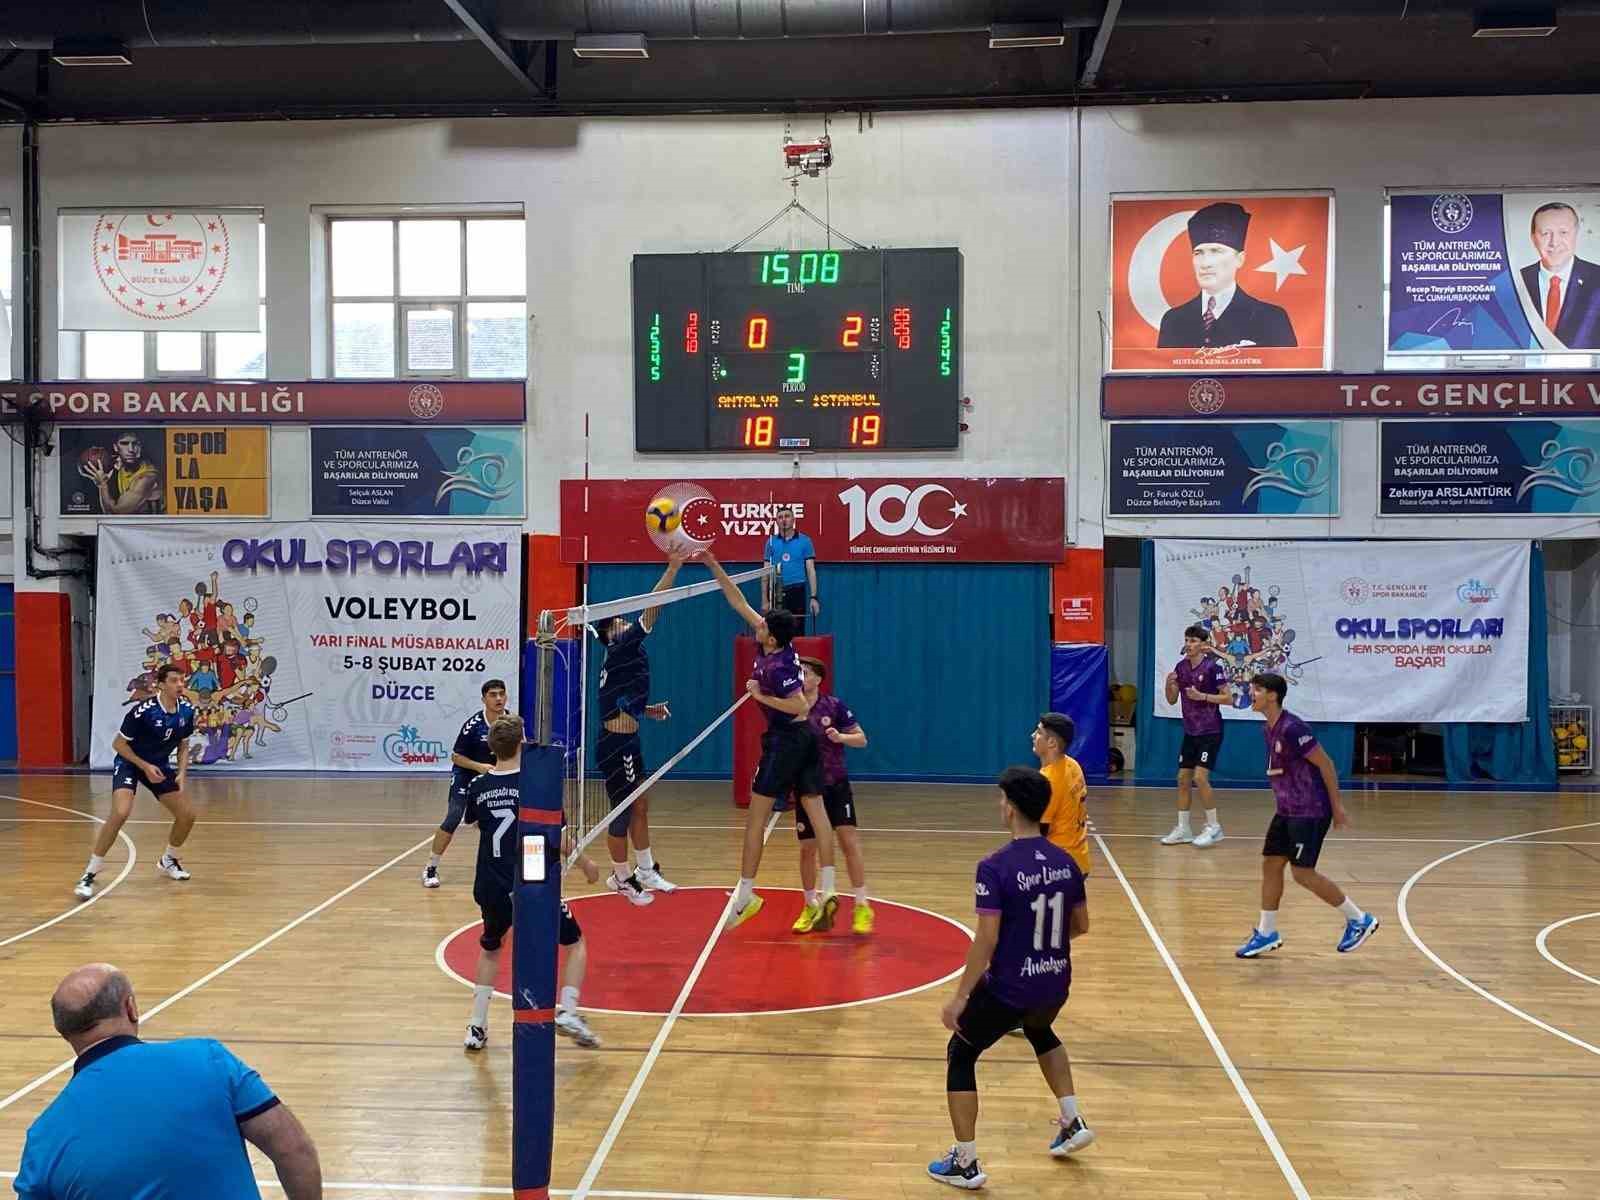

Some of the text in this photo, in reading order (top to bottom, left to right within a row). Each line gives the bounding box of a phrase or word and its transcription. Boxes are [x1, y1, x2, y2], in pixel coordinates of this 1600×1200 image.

[1413, 240, 1490, 250] TÜM ANTRENÖR
[1401, 251, 1502, 260] VE SPORCULARIMIZA
[1401, 262, 1501, 273] BAŞARILAR DİLİYORUM
[787, 282, 806, 294] TIME
[1406, 284, 1496, 294] Recep Tayyip ERDOĞAN
[748, 318, 768, 349] 0
[843, 316, 862, 347] 2
[787, 353, 806, 383] 3
[782, 382, 806, 393] PERIOD
[1340, 378, 1600, 408] T.C. GENÇLİK V
[1, 393, 17, 413] E
[123, 387, 304, 413] BAKANLIĞI
[718, 395, 779, 408] ANTALYA
[744, 416, 774, 446] 18
[851, 415, 881, 445] 19
[174, 432, 227, 455] SPOR
[1135, 445, 1214, 456] TÜM ANTRENÖR
[1407, 444, 1488, 454] TÜM ANTRENÖR
[336, 449, 408, 459] TÜM ANTRENÖR
[1394, 455, 1499, 465] VE SPORCULARIMIZA
[175, 457, 200, 480] LA
[323, 460, 419, 469] VE SPORCULARIMIZA
[1123, 457, 1225, 466] VE SPORCULARIMIZA
[324, 470, 419, 480] BAŞARILAR DİLİYORUM
[1122, 468, 1225, 479] BAŞARILAR DİLİYORUM
[1394, 466, 1498, 477] BAŞARILAR DİLİYORUM
[174, 486, 228, 512] YAŞA
[1143, 489, 1204, 498] Dr. Faruk ÖZLÜ
[1389, 485, 1512, 500] Zekeriya ARSLANTÜRK
[1153, 498, 1188, 508] Belediye
[838, 484, 957, 542] 100
[222, 538, 508, 576] OKUL SPORLARI
[325, 597, 476, 621] VOLEYBOL
[1336, 617, 1504, 640] OKUL SPORLARI
[310, 635, 342, 647] YARI
[391, 634, 510, 650] MÜSABAKALARI
[1347, 644, 1492, 655] HEM SPORDA HEM OKULDA
[344, 655, 486, 675] 5-8 ŞUBAT 2026
[1395, 656, 1446, 669] BAŞARI
[372, 681, 435, 701] DÜZCE
[1201, 751, 1209, 763] 8
[490, 808, 516, 858] 7
[1295, 843, 1305, 860] 7
[1030, 891, 1065, 952] 11
